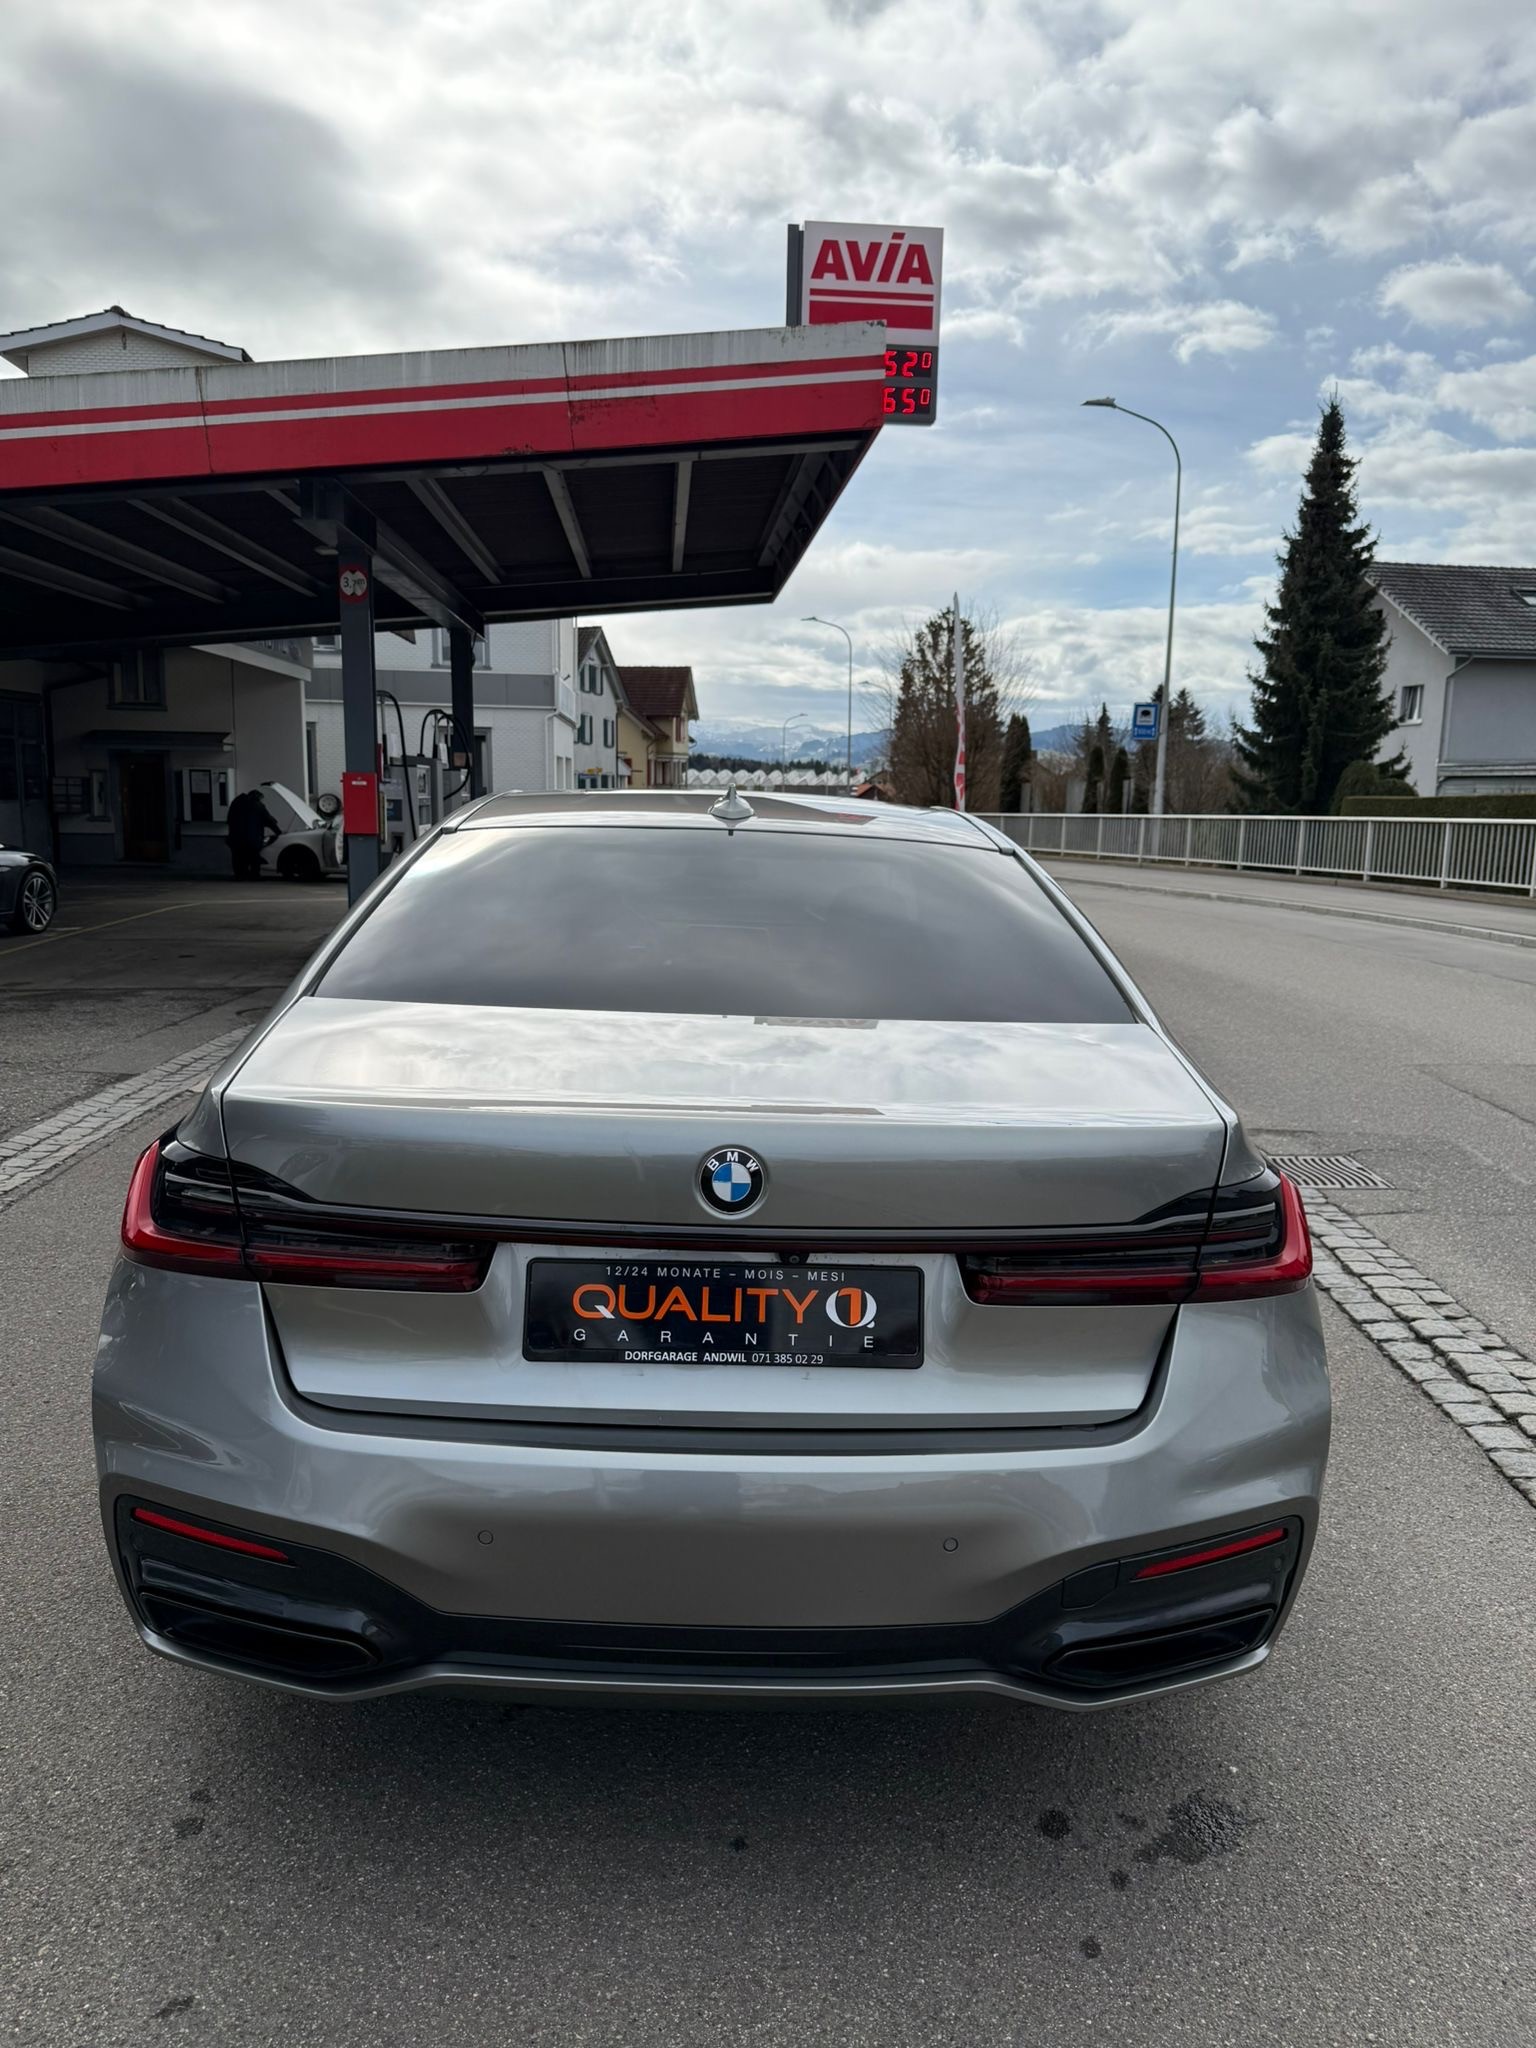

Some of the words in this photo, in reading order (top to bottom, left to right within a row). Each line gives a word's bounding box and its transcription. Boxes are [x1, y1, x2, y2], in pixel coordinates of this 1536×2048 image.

[706, 1151, 760, 1173] BMW
[606, 1266, 648, 1277] 12/24
[657, 1267, 721, 1278] MONATE
[744, 1269, 784, 1280] MOIS
[807, 1271, 845, 1282] MESI
[572, 1283, 819, 1324] QUALITY
[624, 1351, 698, 1362] DORFGARAGE
[703, 1353, 747, 1363] ANDWIL
[751, 1354, 771, 1363] 071
[773, 1354, 793, 1364] 385
[795, 1355, 809, 1364] 02
[811, 1356, 824, 1365] 29
